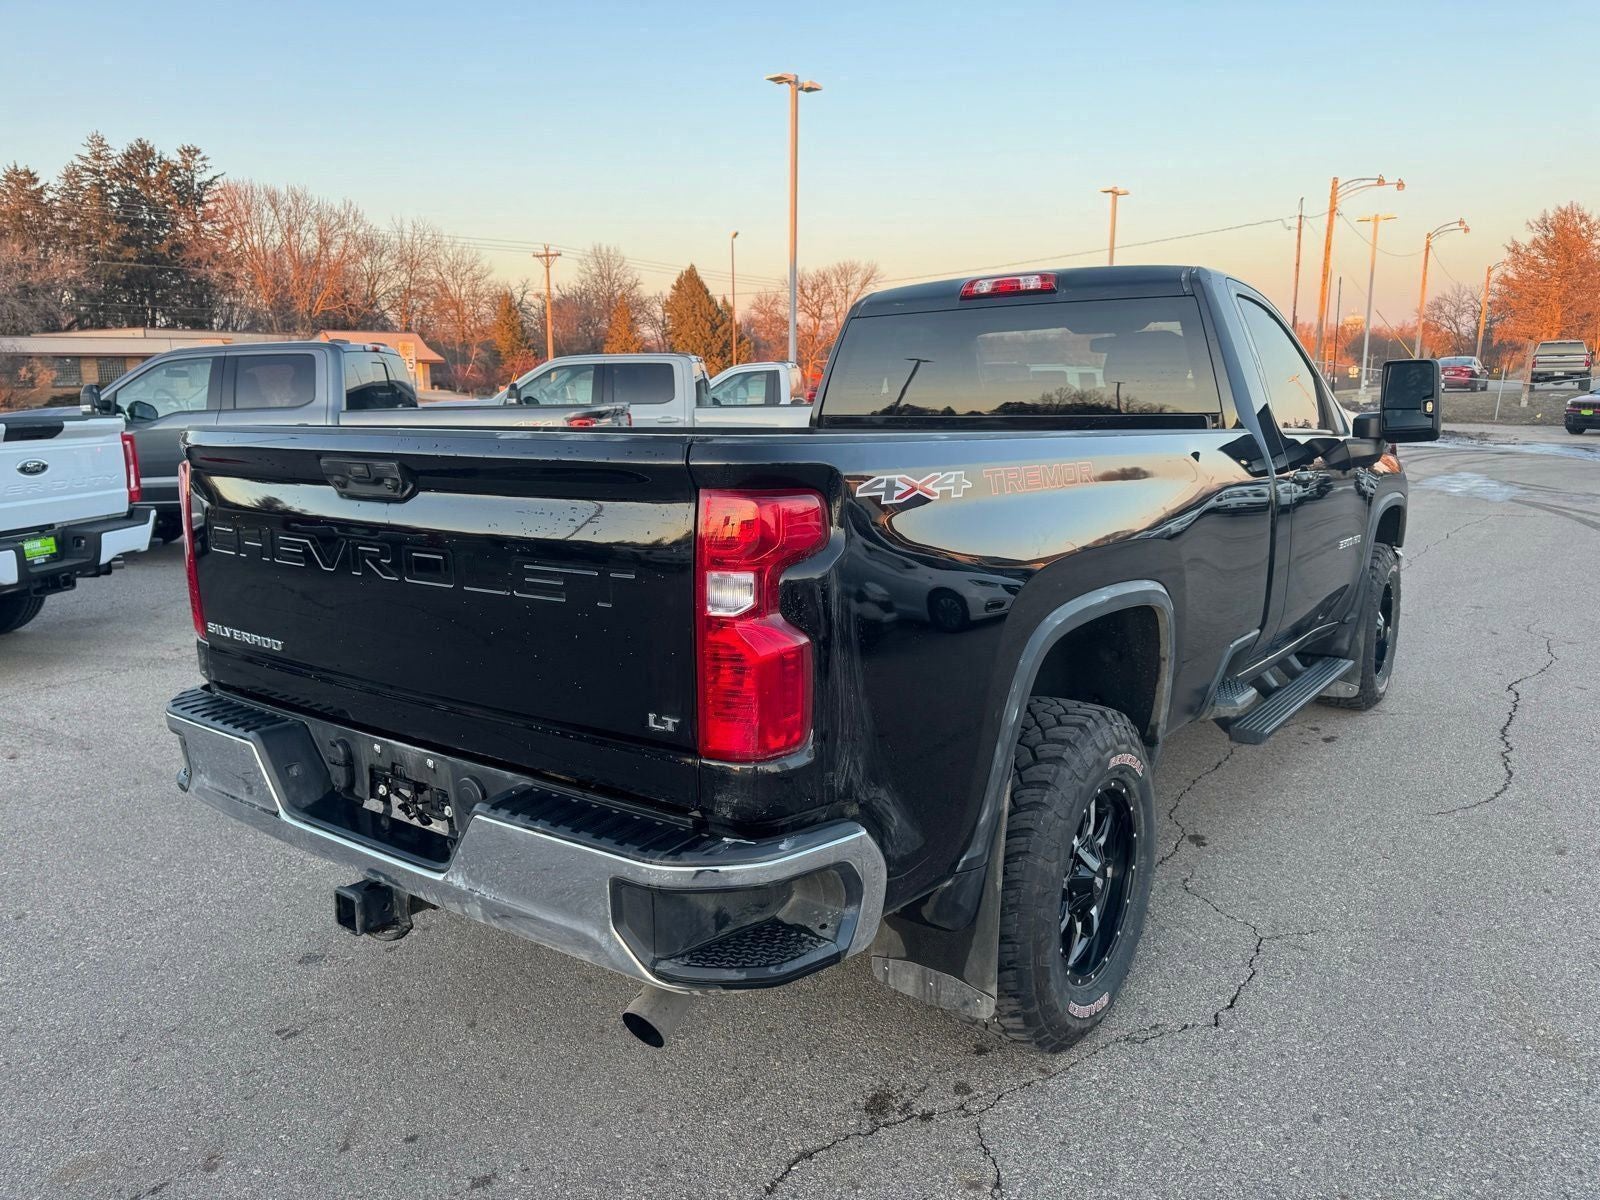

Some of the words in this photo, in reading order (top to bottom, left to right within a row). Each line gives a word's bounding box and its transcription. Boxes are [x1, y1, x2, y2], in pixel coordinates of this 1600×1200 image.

[49, 474, 119, 491] DUTY
[856, 471, 972, 504] 4X4
[983, 461, 1095, 496] TREMOR
[208, 521, 638, 608] CHEVROLET
[207, 621, 284, 651] SILVERADO
[648, 712, 681, 732] LT
